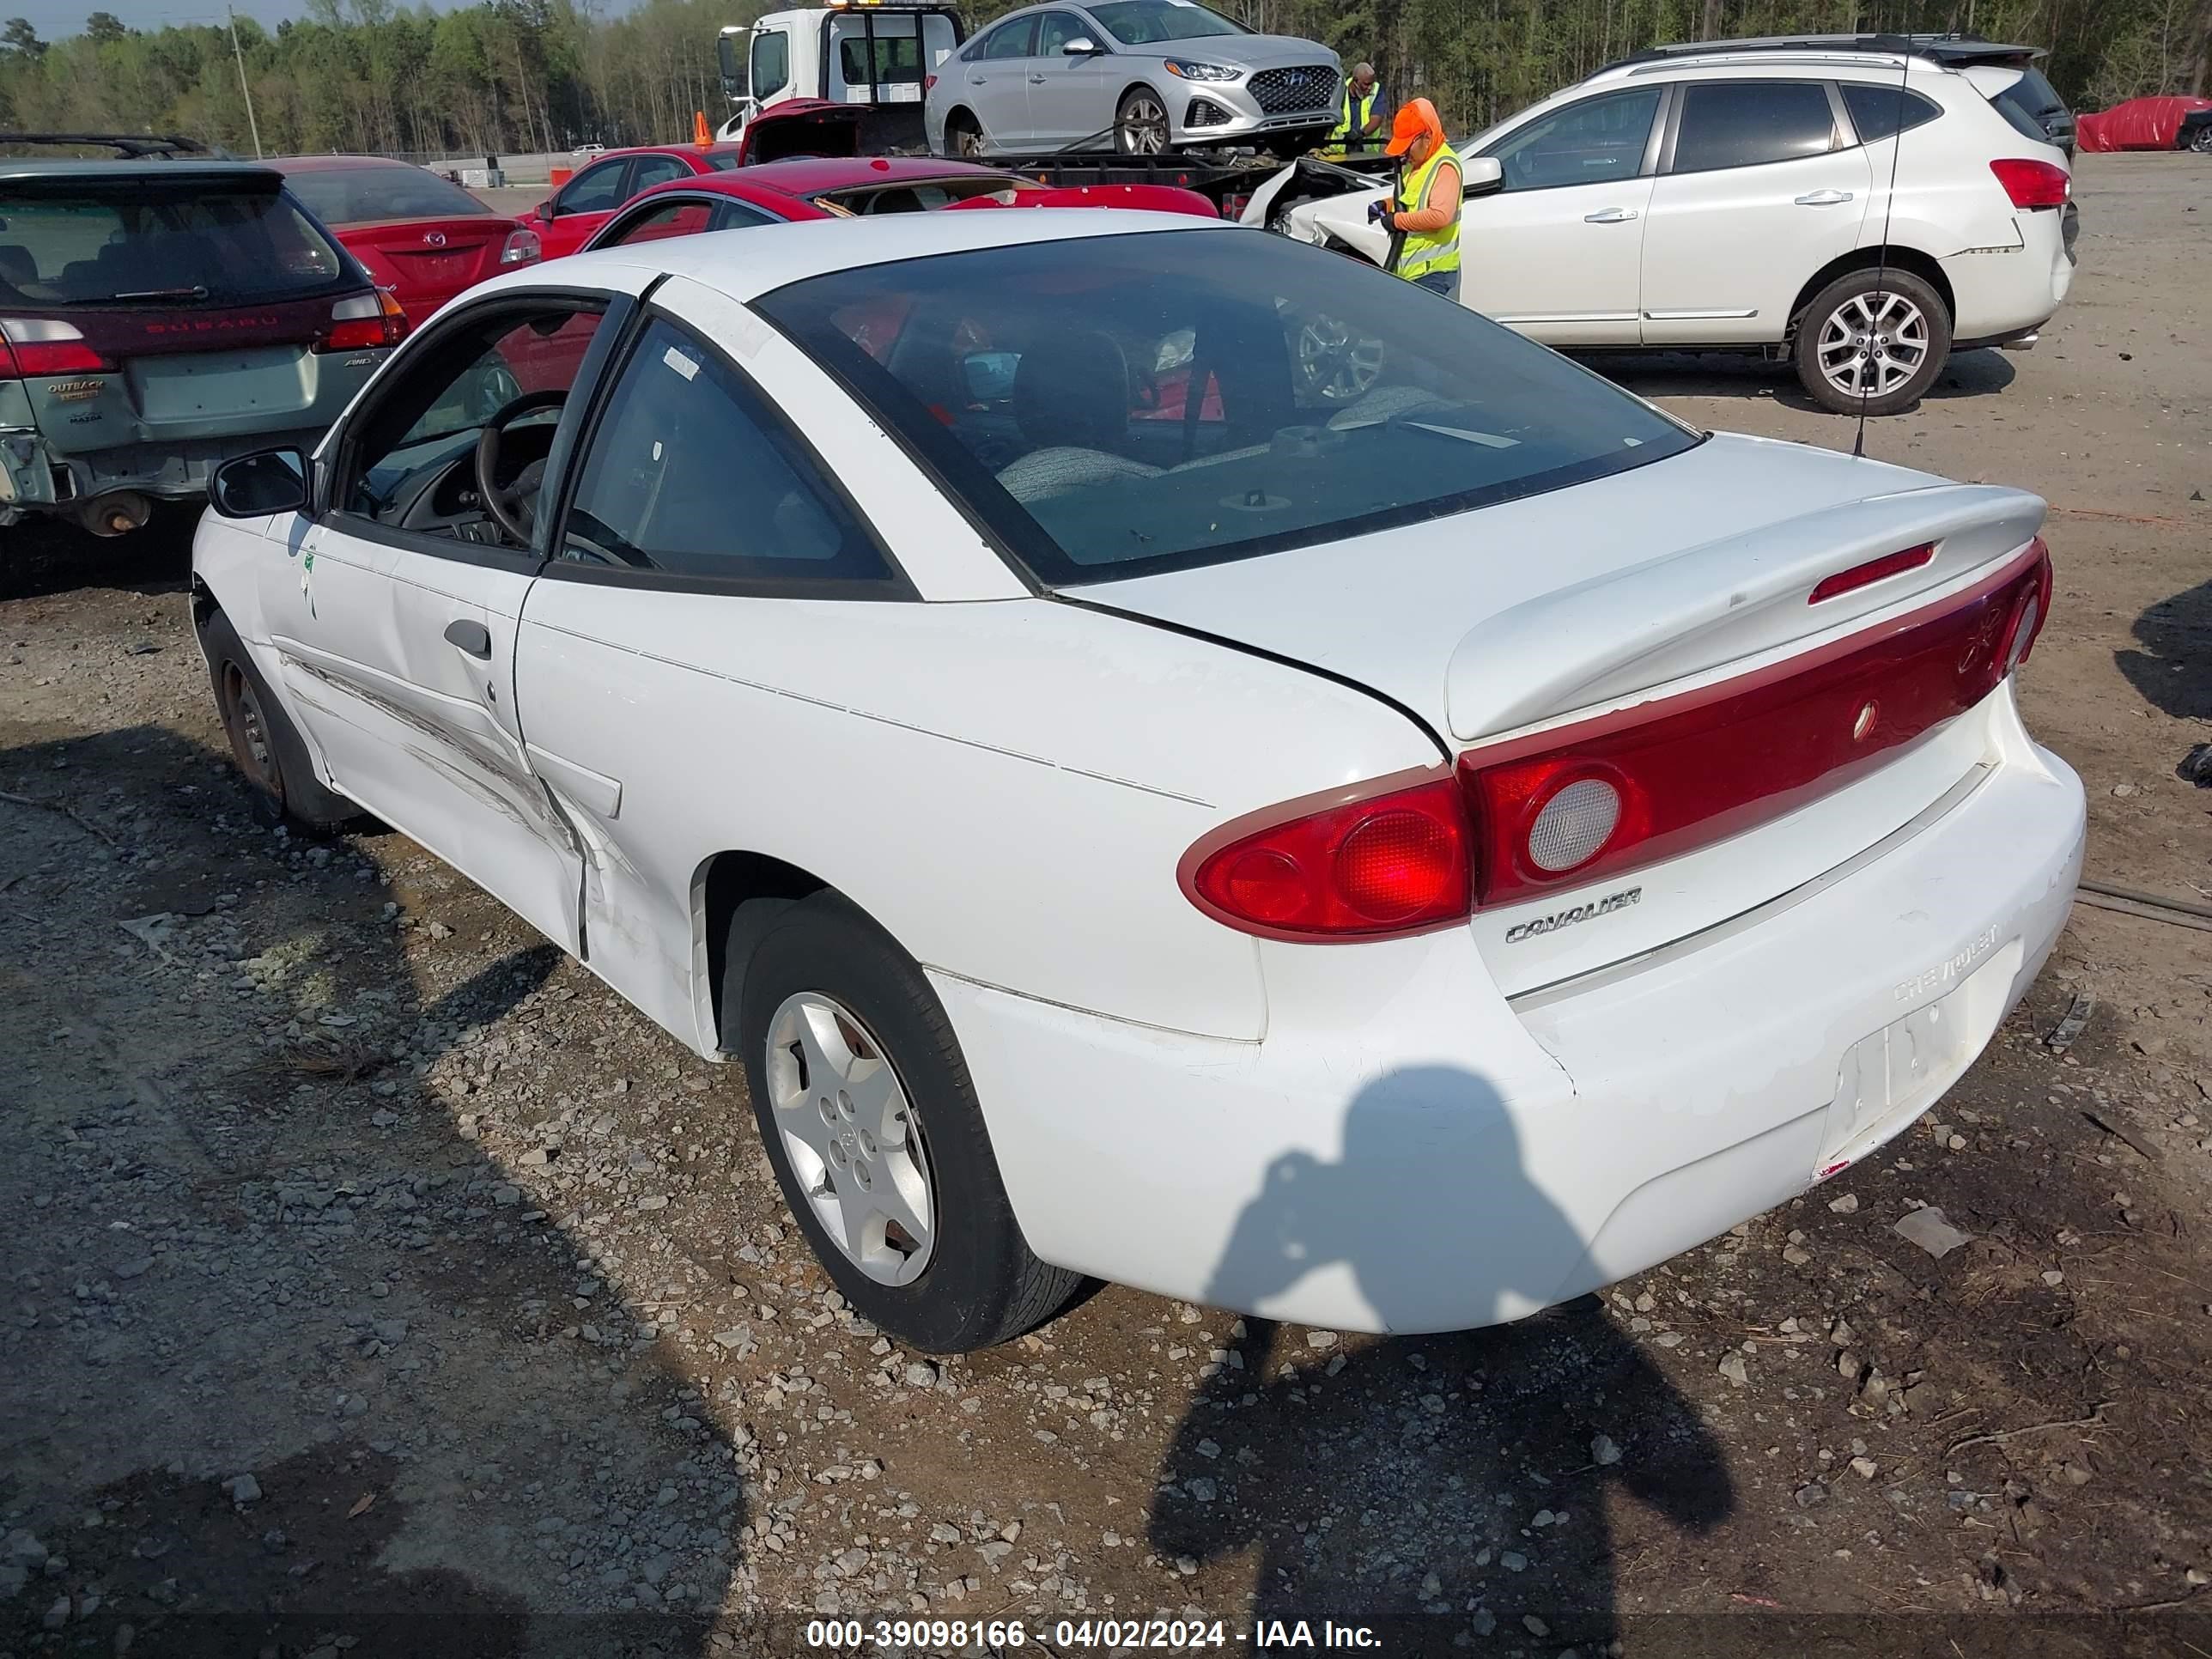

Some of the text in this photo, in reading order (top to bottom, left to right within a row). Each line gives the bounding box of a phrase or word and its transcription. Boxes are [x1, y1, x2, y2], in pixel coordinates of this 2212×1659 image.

[146, 315, 278, 334] SUBARU
[343, 358, 372, 367] AWD
[47, 380, 104, 393] OUTBACK
[69, 414, 103, 424] MAZDA
[1505, 885, 1643, 944] CAVALIER
[1893, 923, 1997, 1002] CHEVROLET
